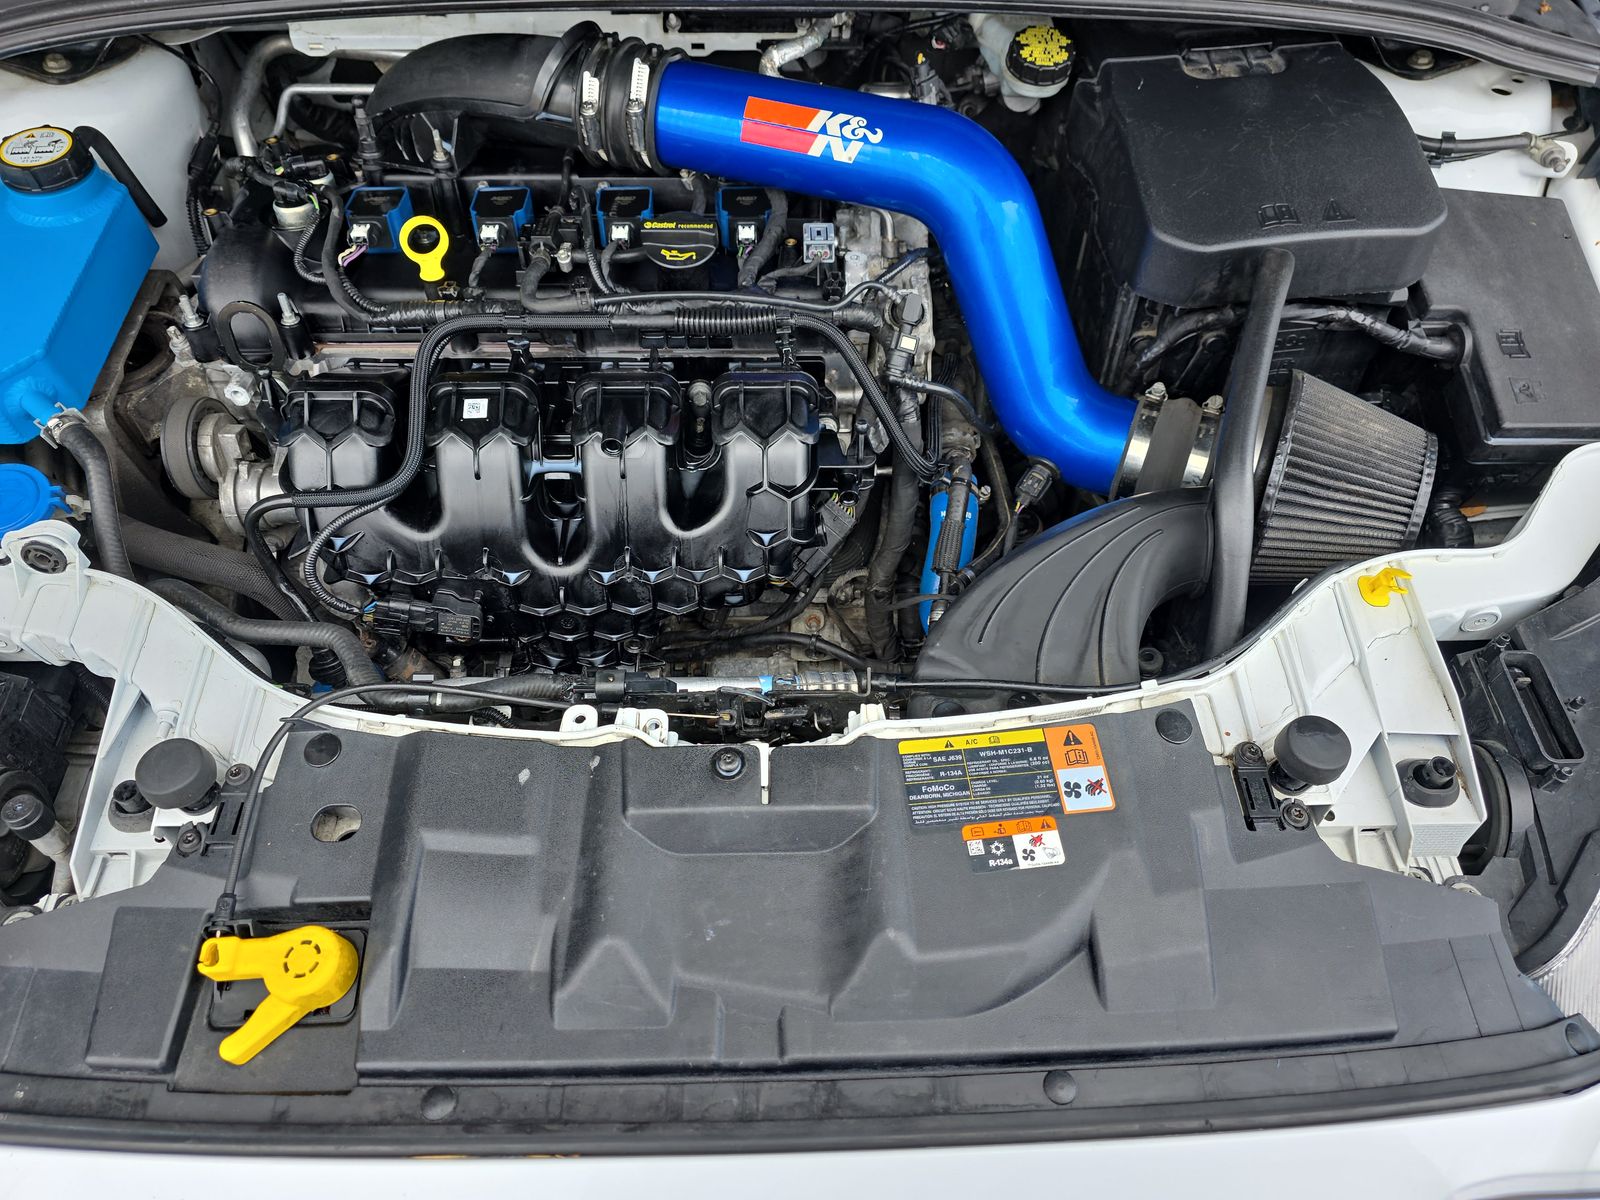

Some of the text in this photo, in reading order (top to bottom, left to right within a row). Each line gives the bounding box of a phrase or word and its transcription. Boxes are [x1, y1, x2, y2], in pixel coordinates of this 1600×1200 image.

[979, 747, 1032, 757] WSH-M1C231-B
[922, 784, 955, 792] FoMoCo
[989, 858, 1013, 867] R-134a
